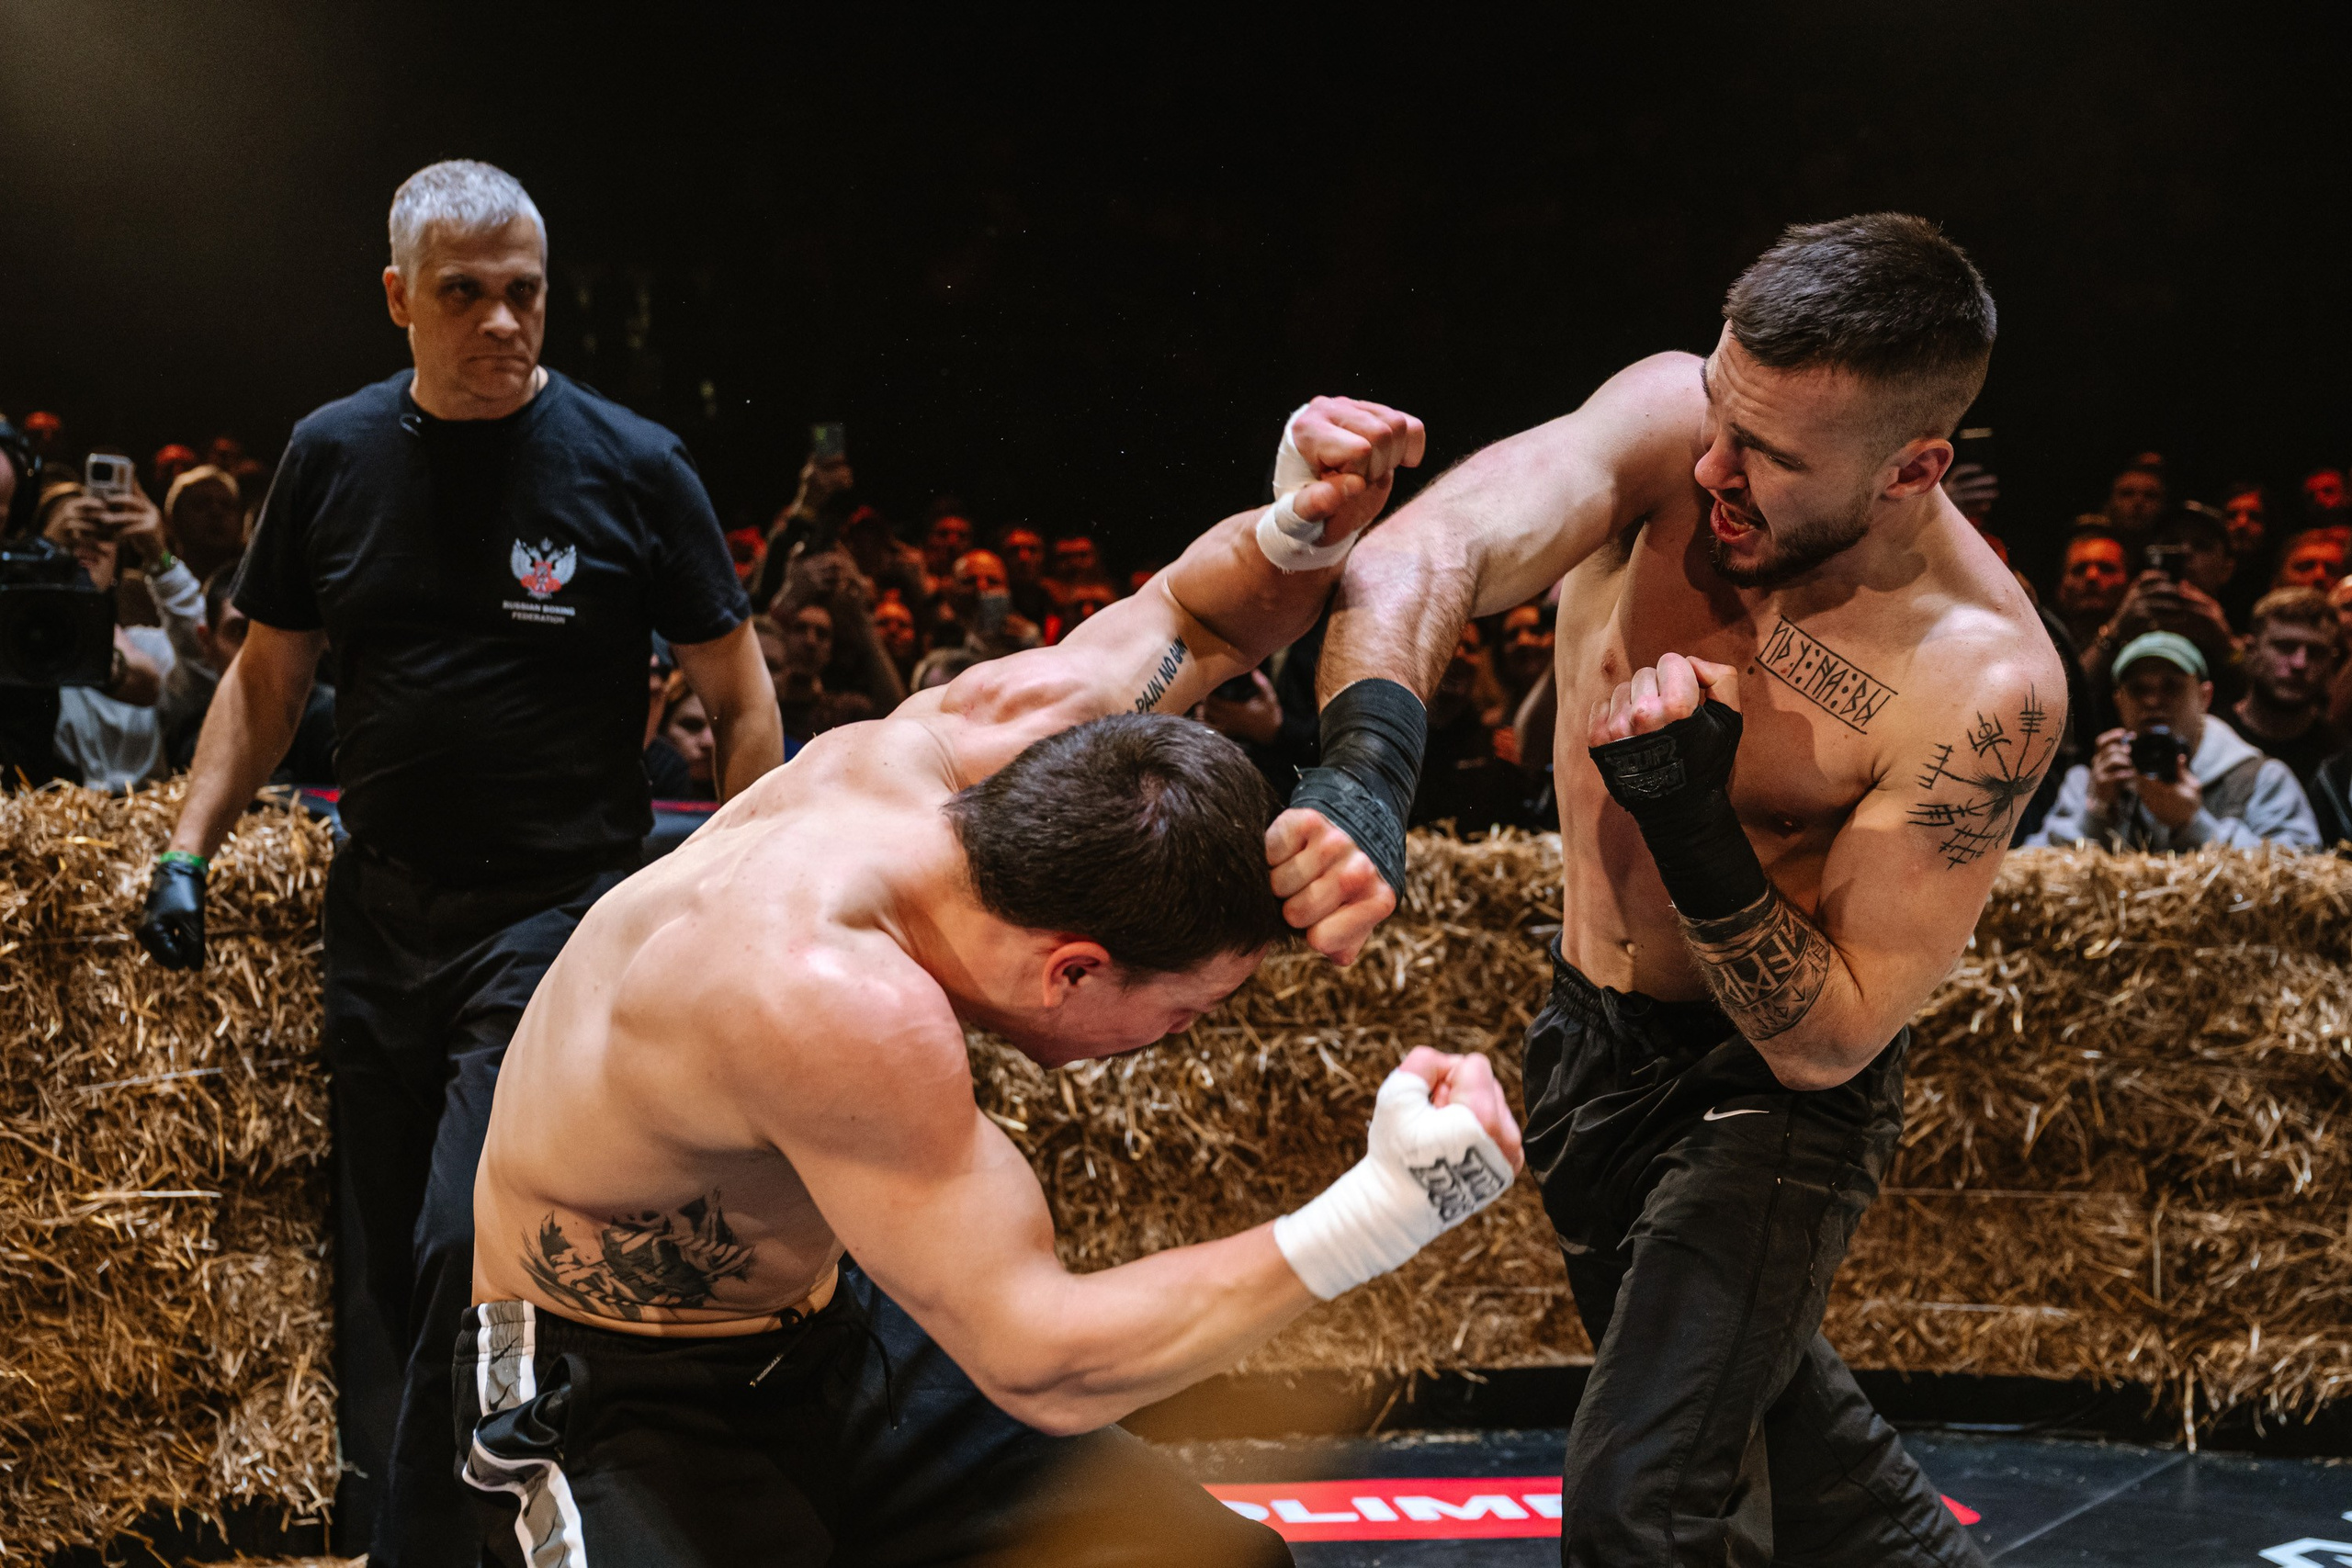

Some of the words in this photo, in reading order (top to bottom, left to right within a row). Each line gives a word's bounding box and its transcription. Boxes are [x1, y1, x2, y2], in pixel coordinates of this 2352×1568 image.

[503, 600, 541, 612] RUSSIAN
[542, 604, 576, 616] BOXING
[511, 611, 566, 625] FEDERATION
[1135, 674, 1166, 715] PAIN
[1158, 656, 1178, 685] NO
